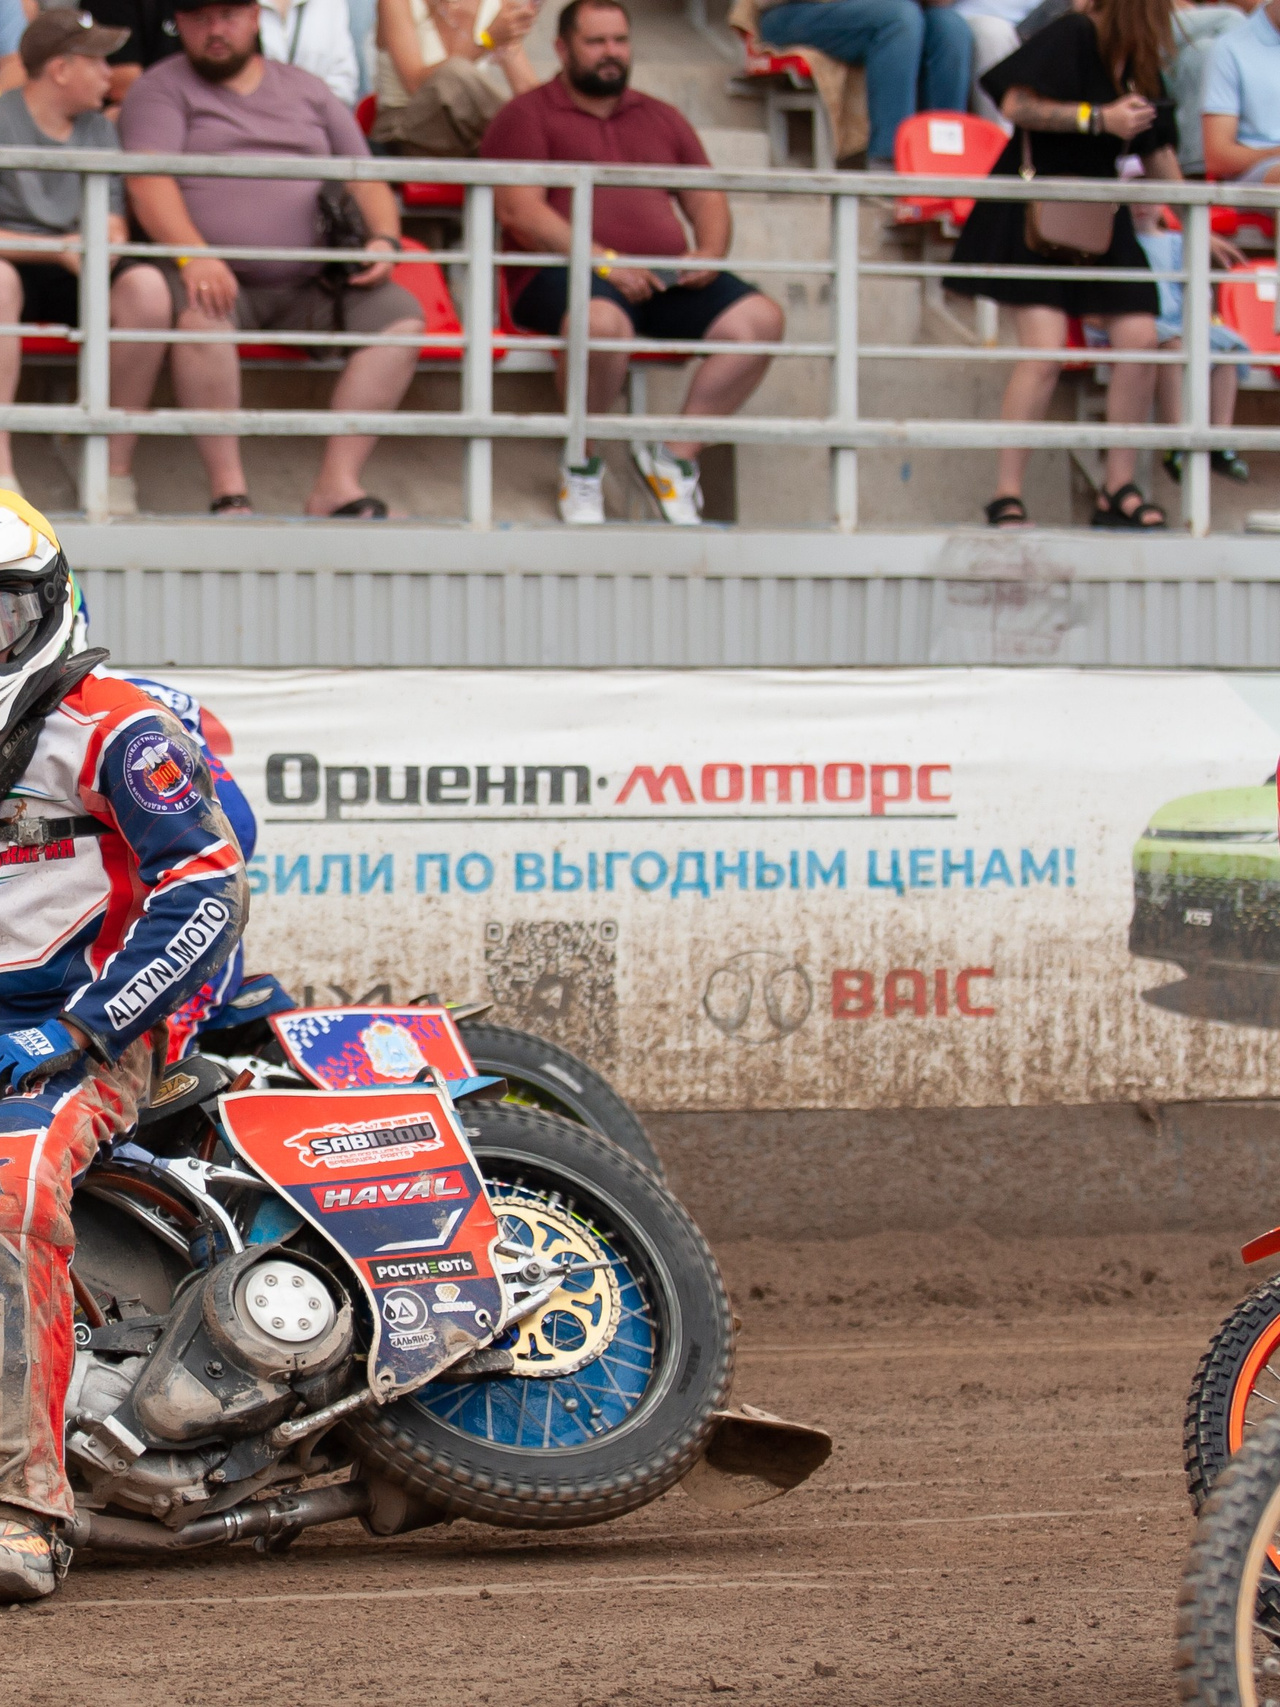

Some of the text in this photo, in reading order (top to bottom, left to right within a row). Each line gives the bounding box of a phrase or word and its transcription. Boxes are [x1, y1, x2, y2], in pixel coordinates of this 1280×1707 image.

[174, 790, 198, 811] MFR
[415, 850, 495, 894] ПО
[514, 849, 848, 899] ВЫГОДНЫМ
[867, 848, 1076, 897] ЦЕНАМ!
[832, 967, 995, 1019] BAIC
[323, 1177, 462, 1209] HAVAL
[376, 1259, 473, 1279] РОСТНЕФТЬ
